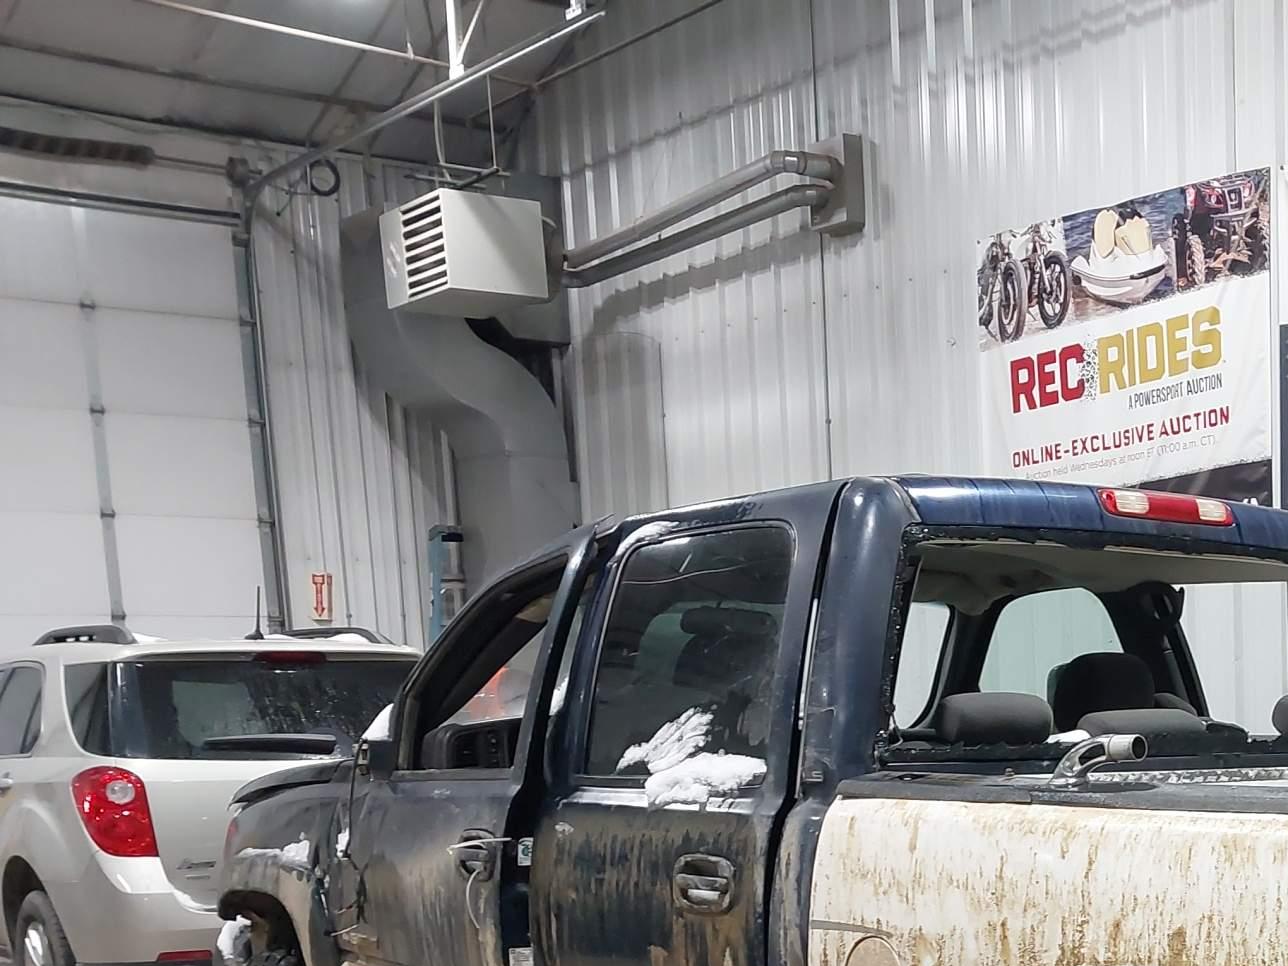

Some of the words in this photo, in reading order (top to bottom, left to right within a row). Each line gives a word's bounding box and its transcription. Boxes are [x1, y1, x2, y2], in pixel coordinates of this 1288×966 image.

[1010, 343, 1086, 414] REC
[1097, 305, 1222, 394] RIDES
[1128, 395, 1133, 410] A
[1134, 382, 1183, 408] POWERSPORT
[1187, 373, 1223, 396] AUCTION
[1012, 423, 1155, 468] ONLINE-EXCLUSIVE
[1159, 405, 1230, 438] AUCTION
